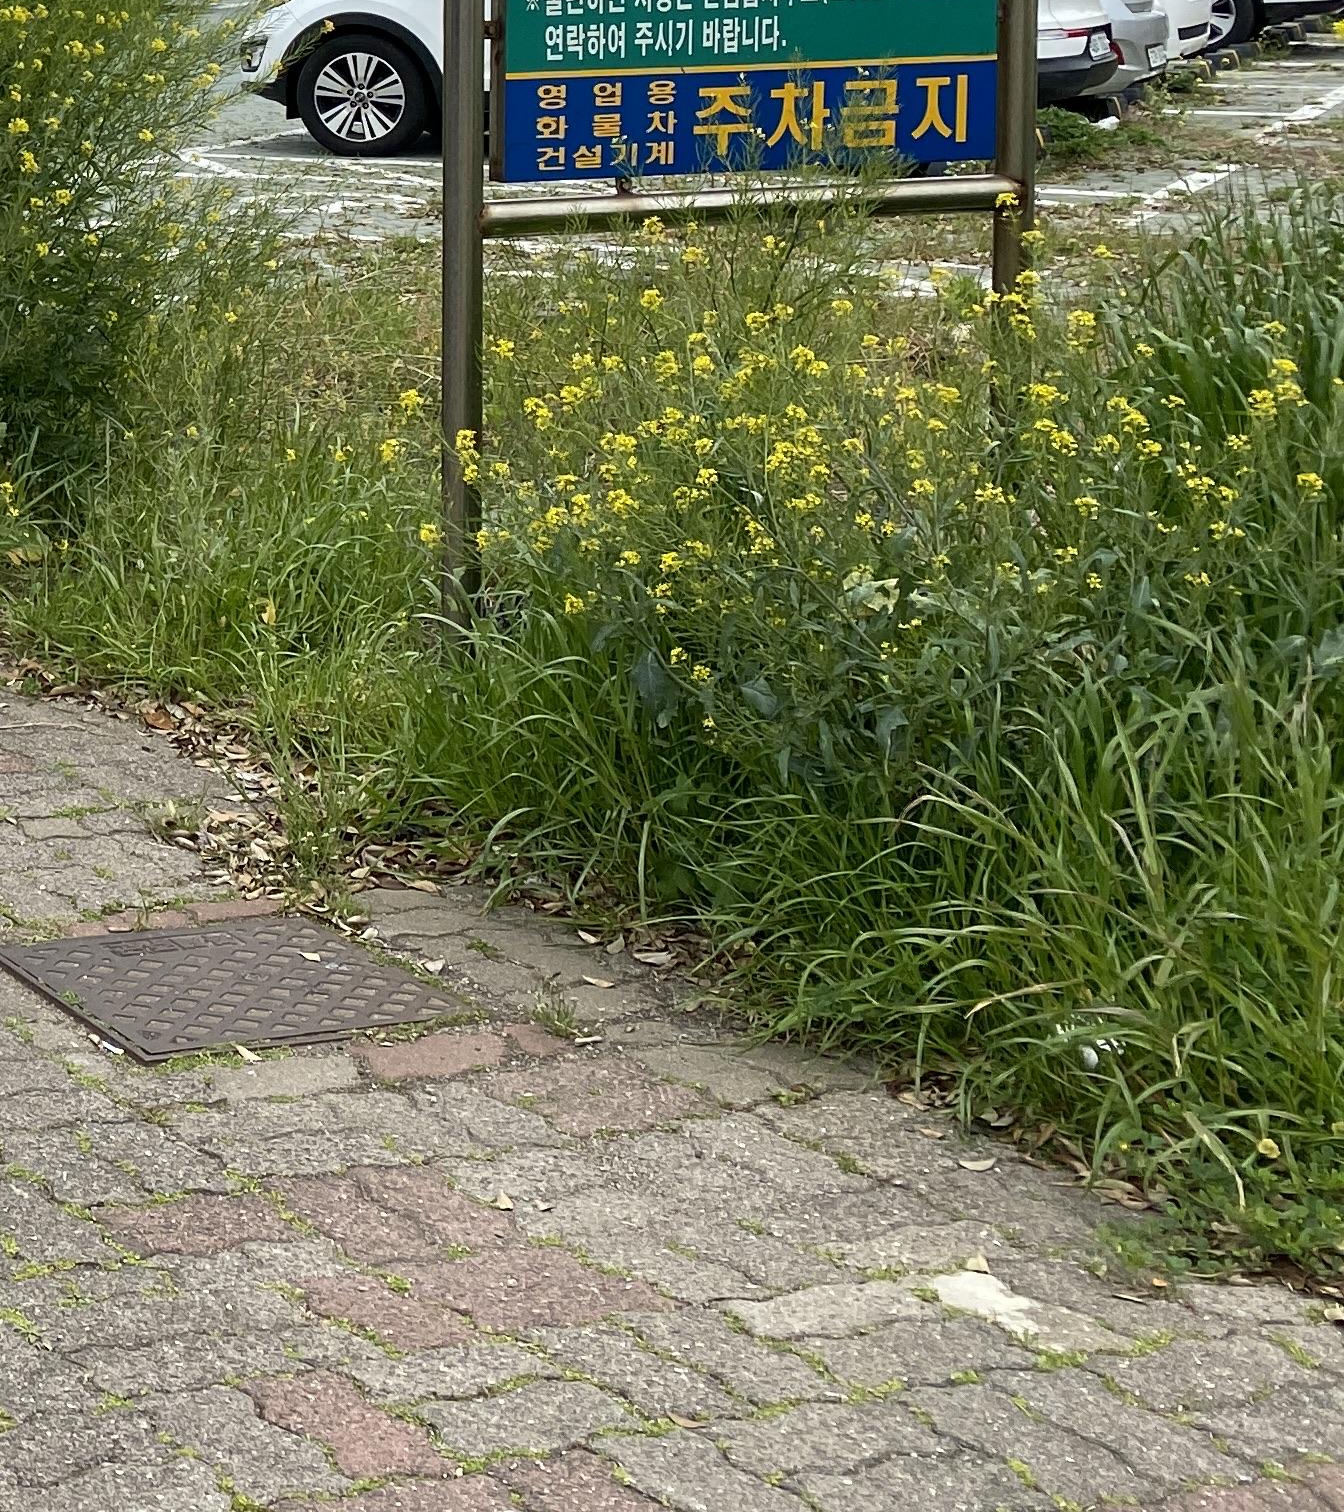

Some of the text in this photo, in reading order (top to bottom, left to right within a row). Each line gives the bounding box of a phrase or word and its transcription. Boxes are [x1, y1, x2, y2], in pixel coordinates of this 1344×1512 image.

[545, 15, 787, 61] 연락하여 주시기 바랍니다.
[693, 74, 968, 156] 주차금지
